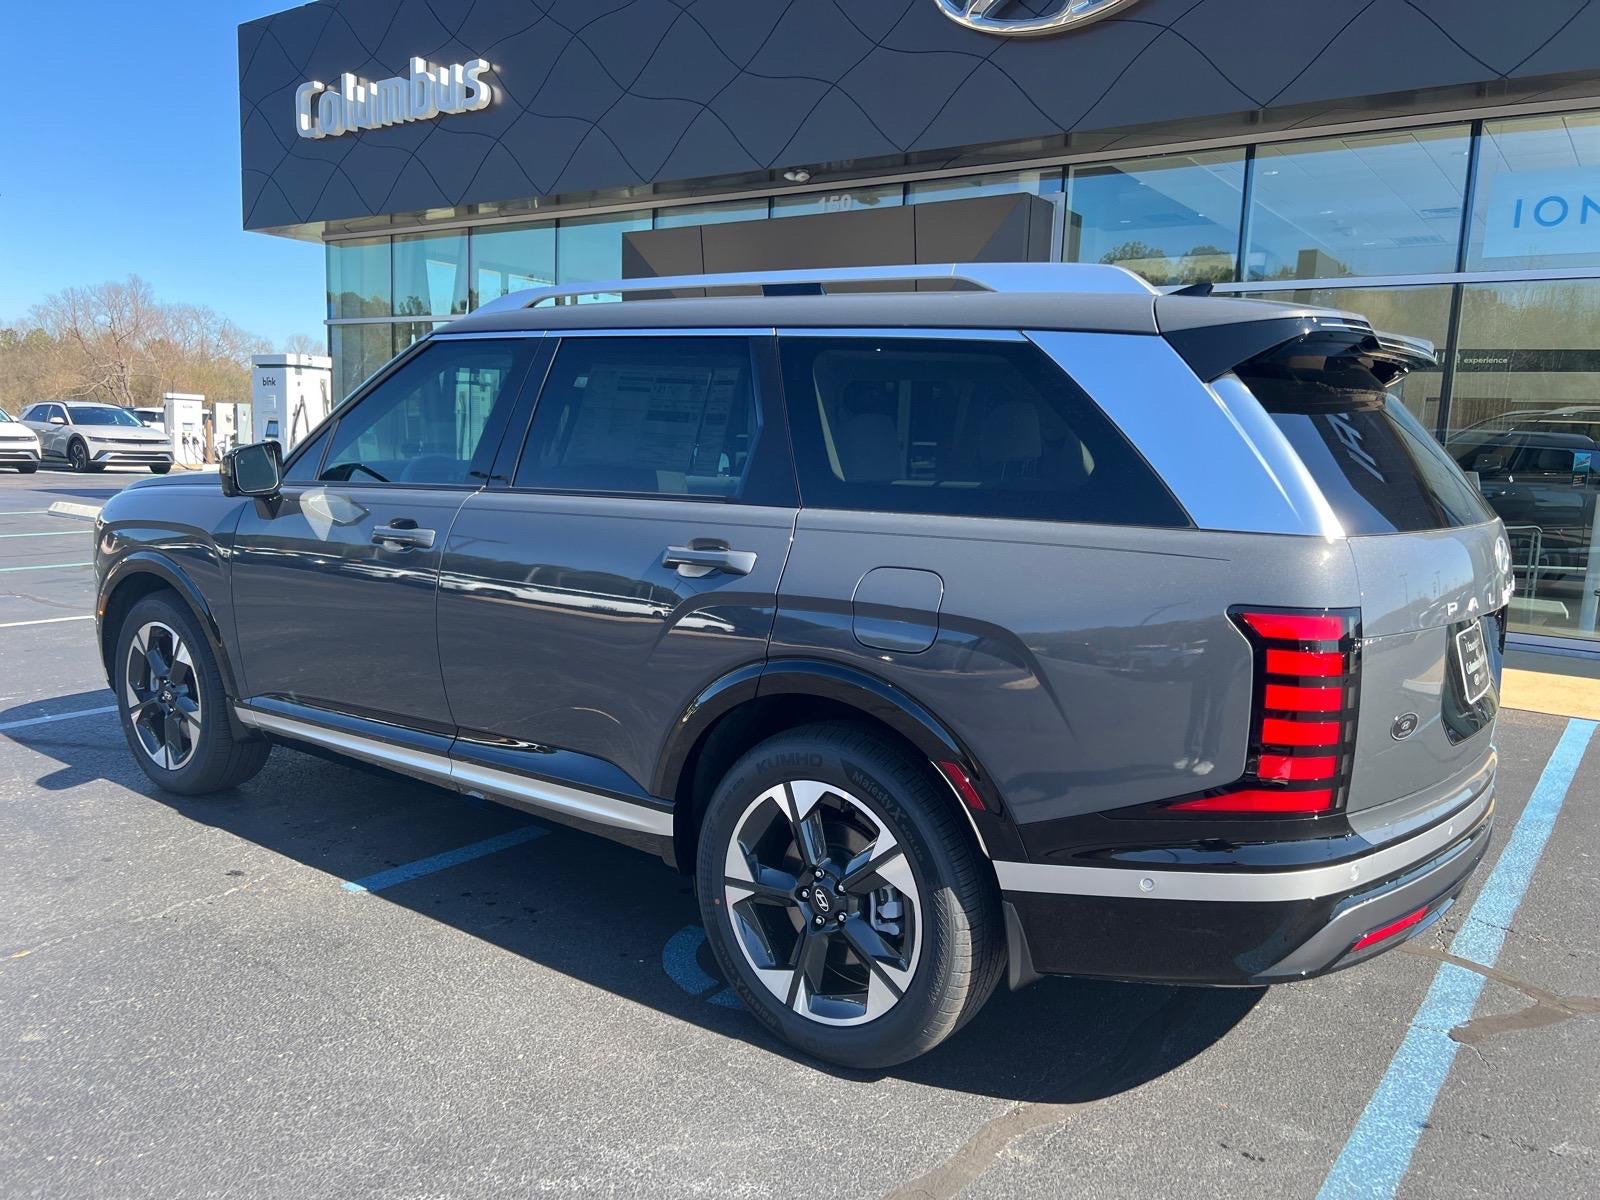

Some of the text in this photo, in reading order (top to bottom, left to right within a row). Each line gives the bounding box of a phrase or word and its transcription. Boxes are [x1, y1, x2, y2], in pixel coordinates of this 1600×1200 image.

[295, 56, 492, 139] Columbus
[1463, 356, 1508, 365] experience
[262, 376, 277, 387] blink
[756, 751, 824, 775] KUMHO
